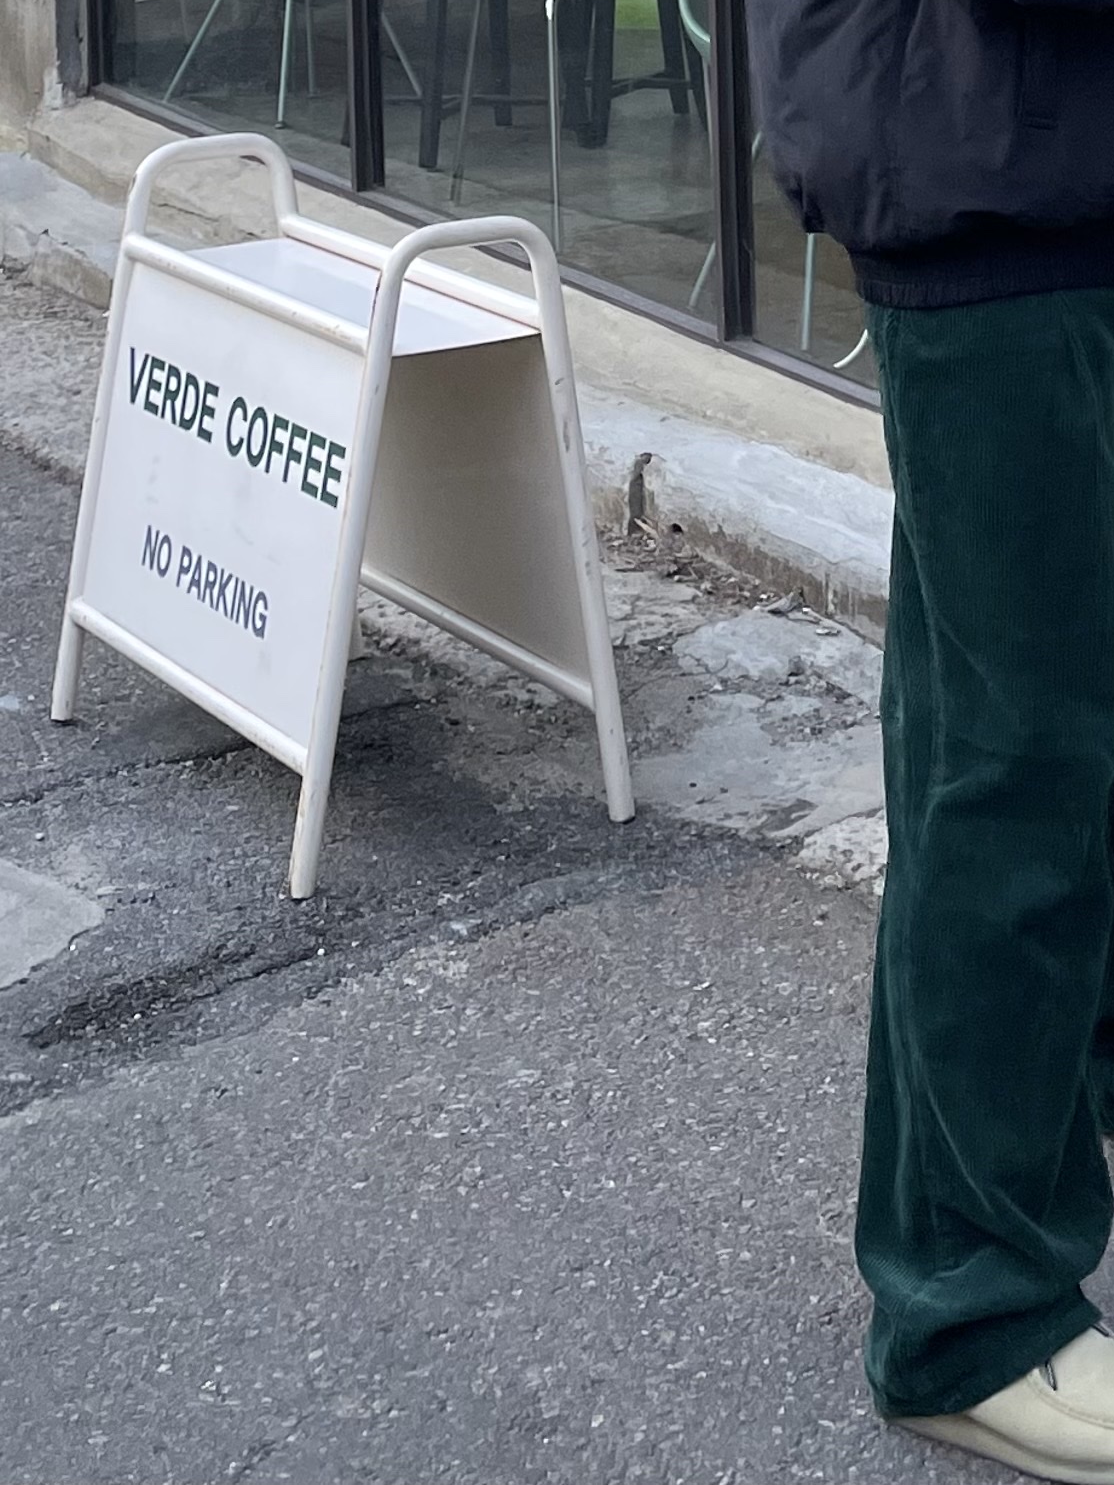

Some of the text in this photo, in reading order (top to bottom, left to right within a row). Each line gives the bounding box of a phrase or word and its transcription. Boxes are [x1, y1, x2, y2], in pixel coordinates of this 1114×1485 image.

[130, 346, 347, 508] VERDE COFFEE
[141, 524, 268, 640] NO PARKING
